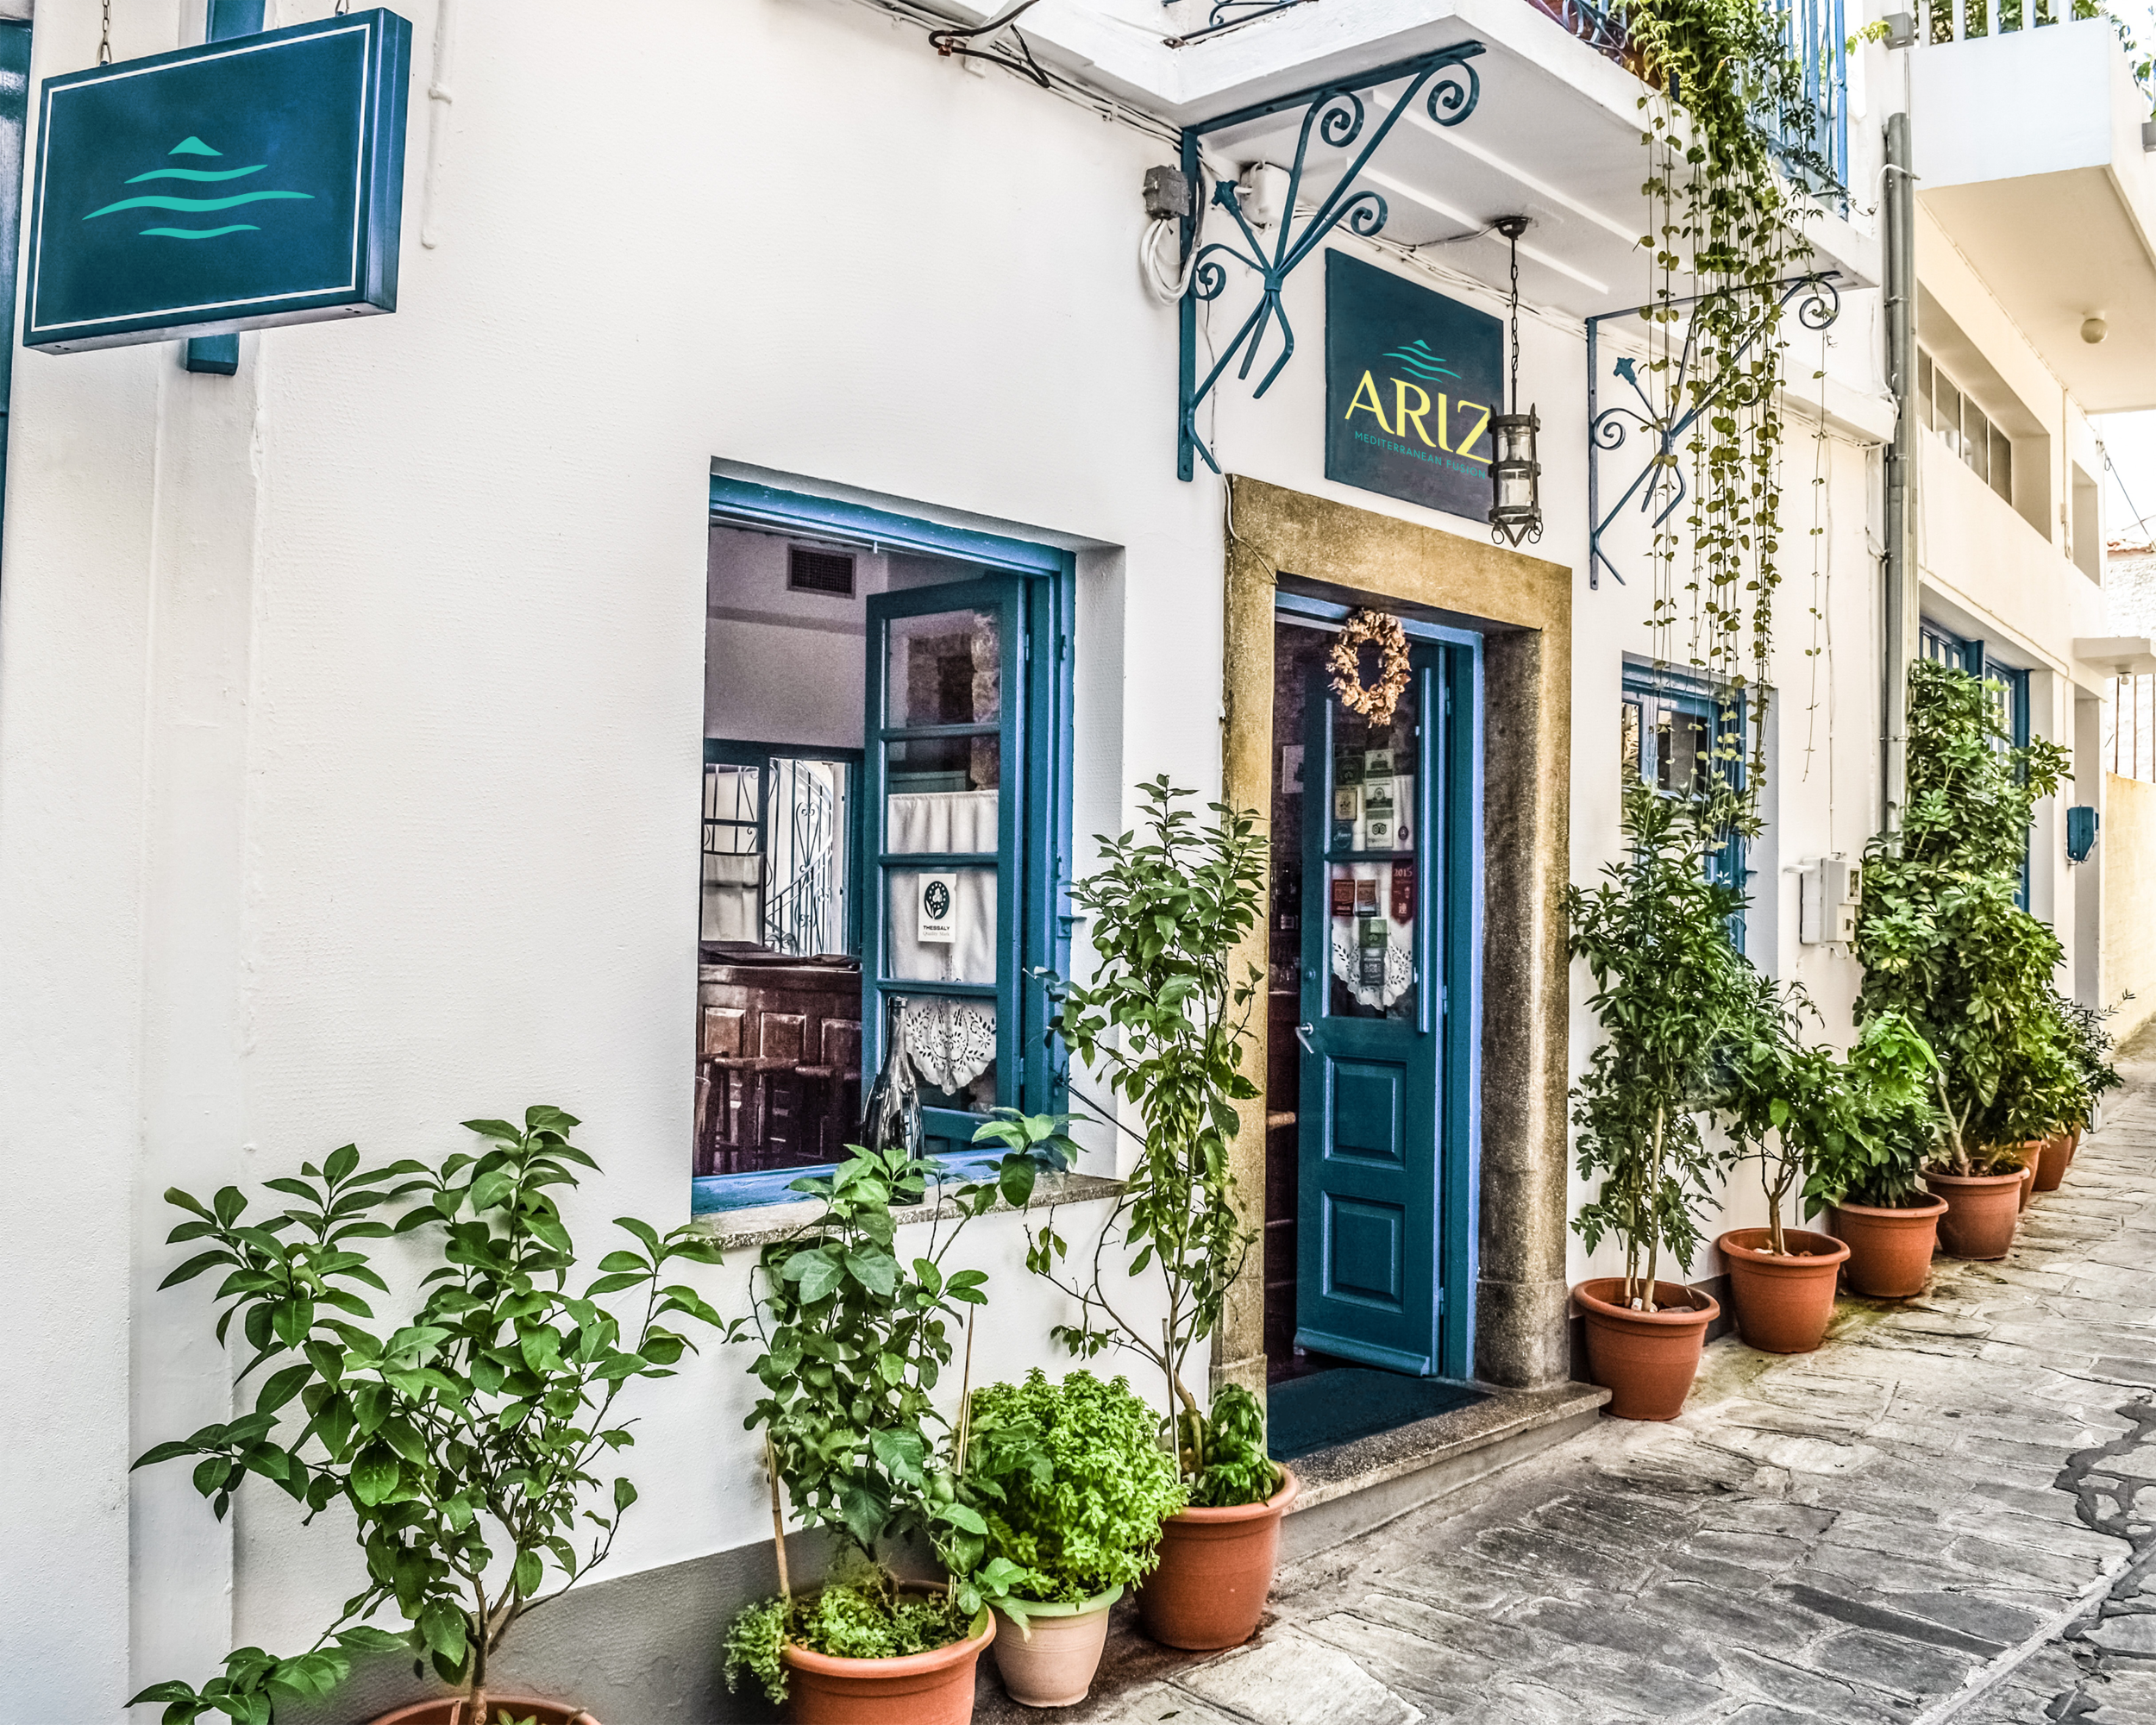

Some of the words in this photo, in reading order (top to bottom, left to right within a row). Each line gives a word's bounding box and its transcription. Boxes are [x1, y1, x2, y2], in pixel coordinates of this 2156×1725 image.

[1344, 369, 1493, 464] ARIZ
[1355, 430, 1442, 466] MEDITERRANEAN
[1446, 459, 1486, 480] FUSION
[1394, 866, 1413, 876] 2015
